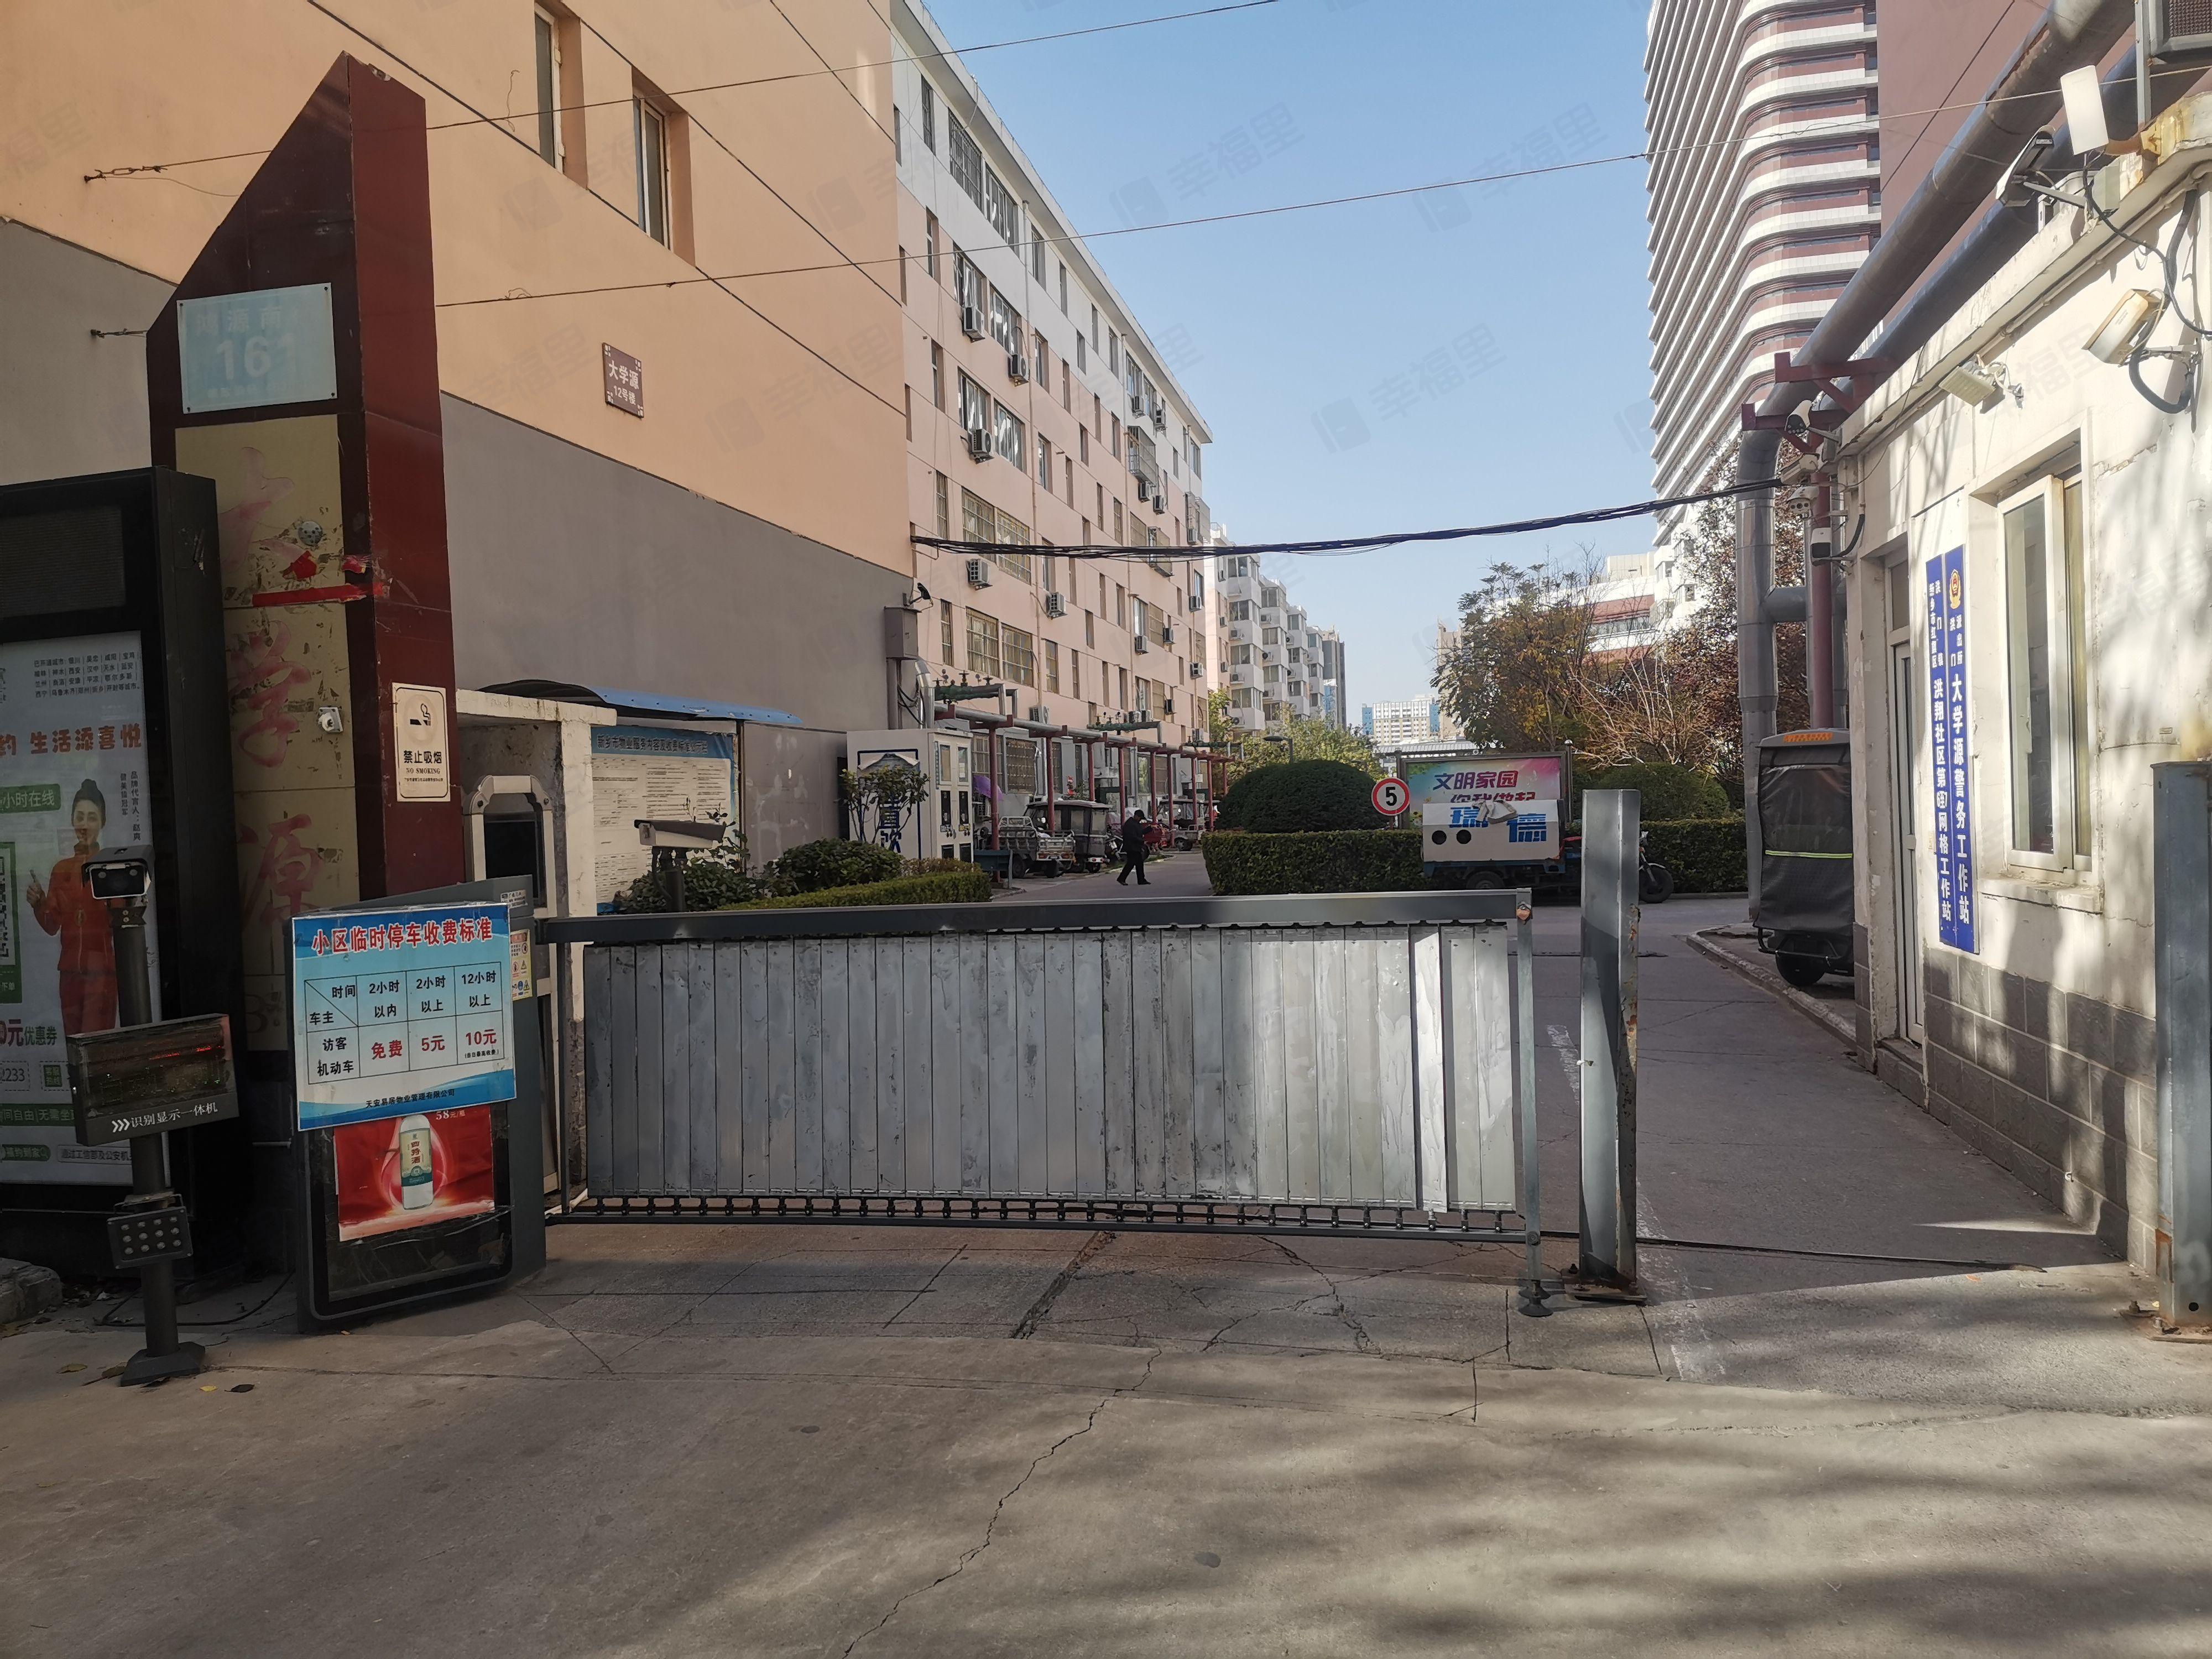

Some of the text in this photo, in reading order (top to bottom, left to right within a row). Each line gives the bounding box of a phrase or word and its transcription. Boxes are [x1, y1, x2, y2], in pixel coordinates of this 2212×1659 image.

[608, 359, 639, 389] 大学源
[613, 385, 636, 405] 12号楼
[30, 723, 142, 754] 生活添喜悦
[403, 750, 442, 764] 禁止吸烟
[1432, 770, 1519, 790] 文明家园
[1385, 786, 1397, 806] 5
[1952, 673, 1969, 924] 大学源警务工作站
[312, 916, 493, 955] 小区临时停车收费标准
[416, 976, 446, 989] 2小时
[462, 971, 496, 985] 12小时
[332, 984, 356, 998] 时间
[369, 980, 400, 994] 2小时
[421, 1000, 444, 1013] 以上
[469, 994, 491, 1008] 以上
[309, 1011, 335, 1025] 车主
[374, 1005, 397, 1018] 以内
[323, 1037, 347, 1052] 访客
[421, 1035, 445, 1052] 5元
[466, 1029, 497, 1046] 10元
[371, 1040, 403, 1060] 免费
[317, 1060, 354, 1077] 机动车
[366, 1089, 455, 1108] 天安易居物业管理有限公司
